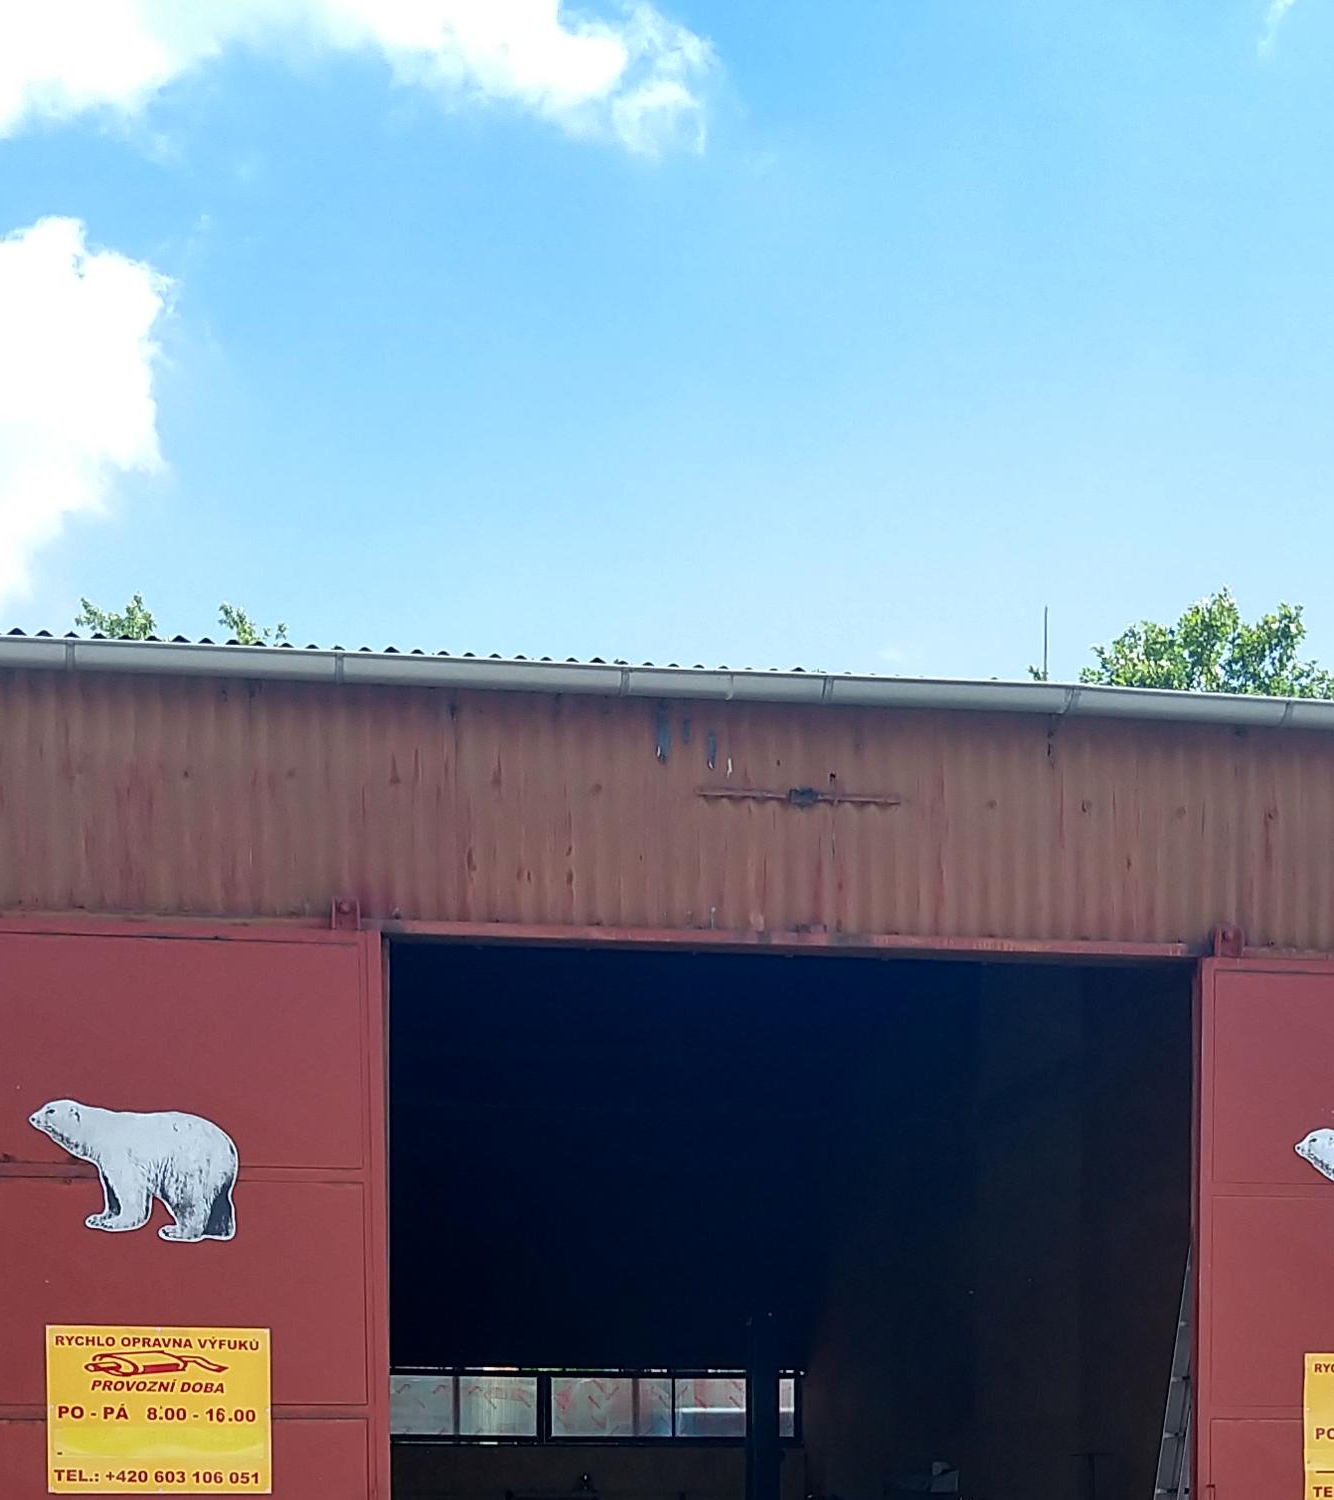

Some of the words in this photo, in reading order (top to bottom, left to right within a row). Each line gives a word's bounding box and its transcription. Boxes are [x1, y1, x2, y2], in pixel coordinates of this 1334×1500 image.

[55, 1336, 115, 1347] RYCHLO
[121, 1337, 193, 1349] OPRAVNA
[91, 1380, 176, 1392] PROVOZNÍ
[180, 1381, 224, 1393] DOBA
[58, 1406, 84, 1419] PO
[103, 1404, 129, 1419] PÁ
[206, 1408, 256, 1422] 16.00
[54, 1470, 99, 1482] TEL.:
[105, 1470, 148, 1483] +420
[154, 1471, 185, 1483] 603
[192, 1472, 223, 1484] 106
[229, 1472, 259, 1484] 051
